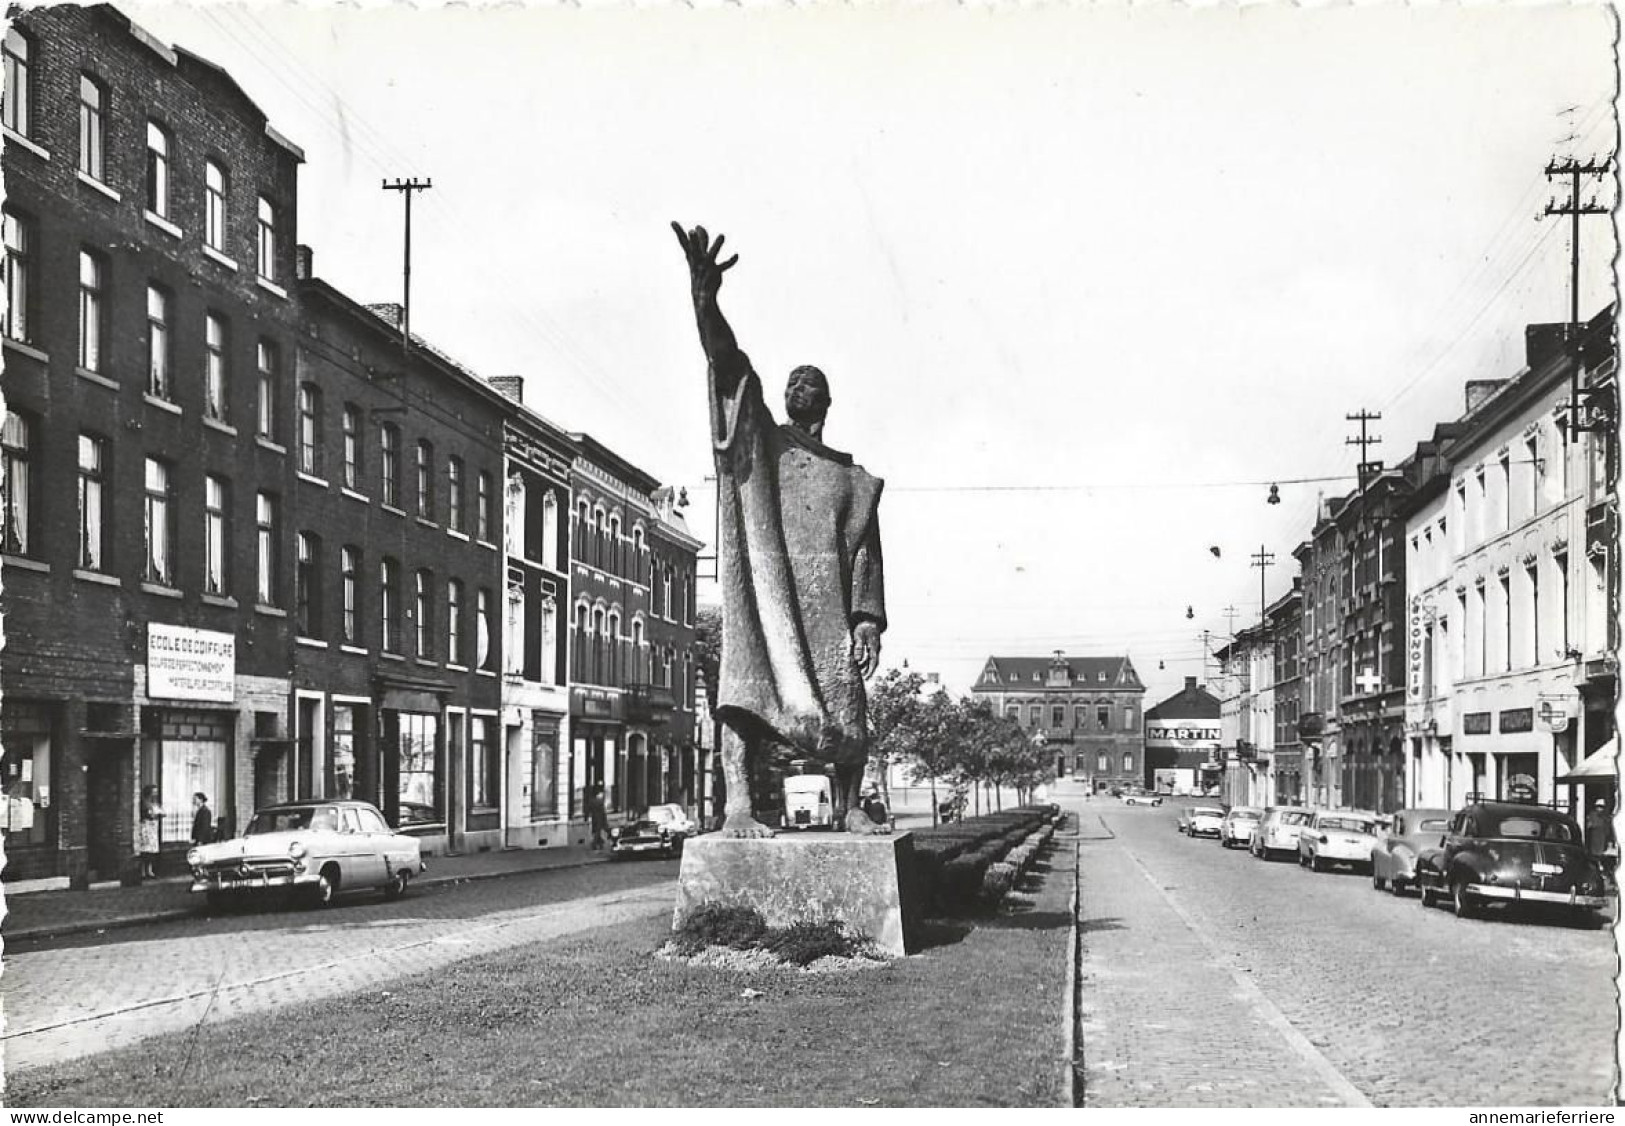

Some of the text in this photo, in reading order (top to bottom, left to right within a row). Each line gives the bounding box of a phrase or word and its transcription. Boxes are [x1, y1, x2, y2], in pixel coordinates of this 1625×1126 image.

[150, 634, 233, 658] ECOLE DE COIFFURE
